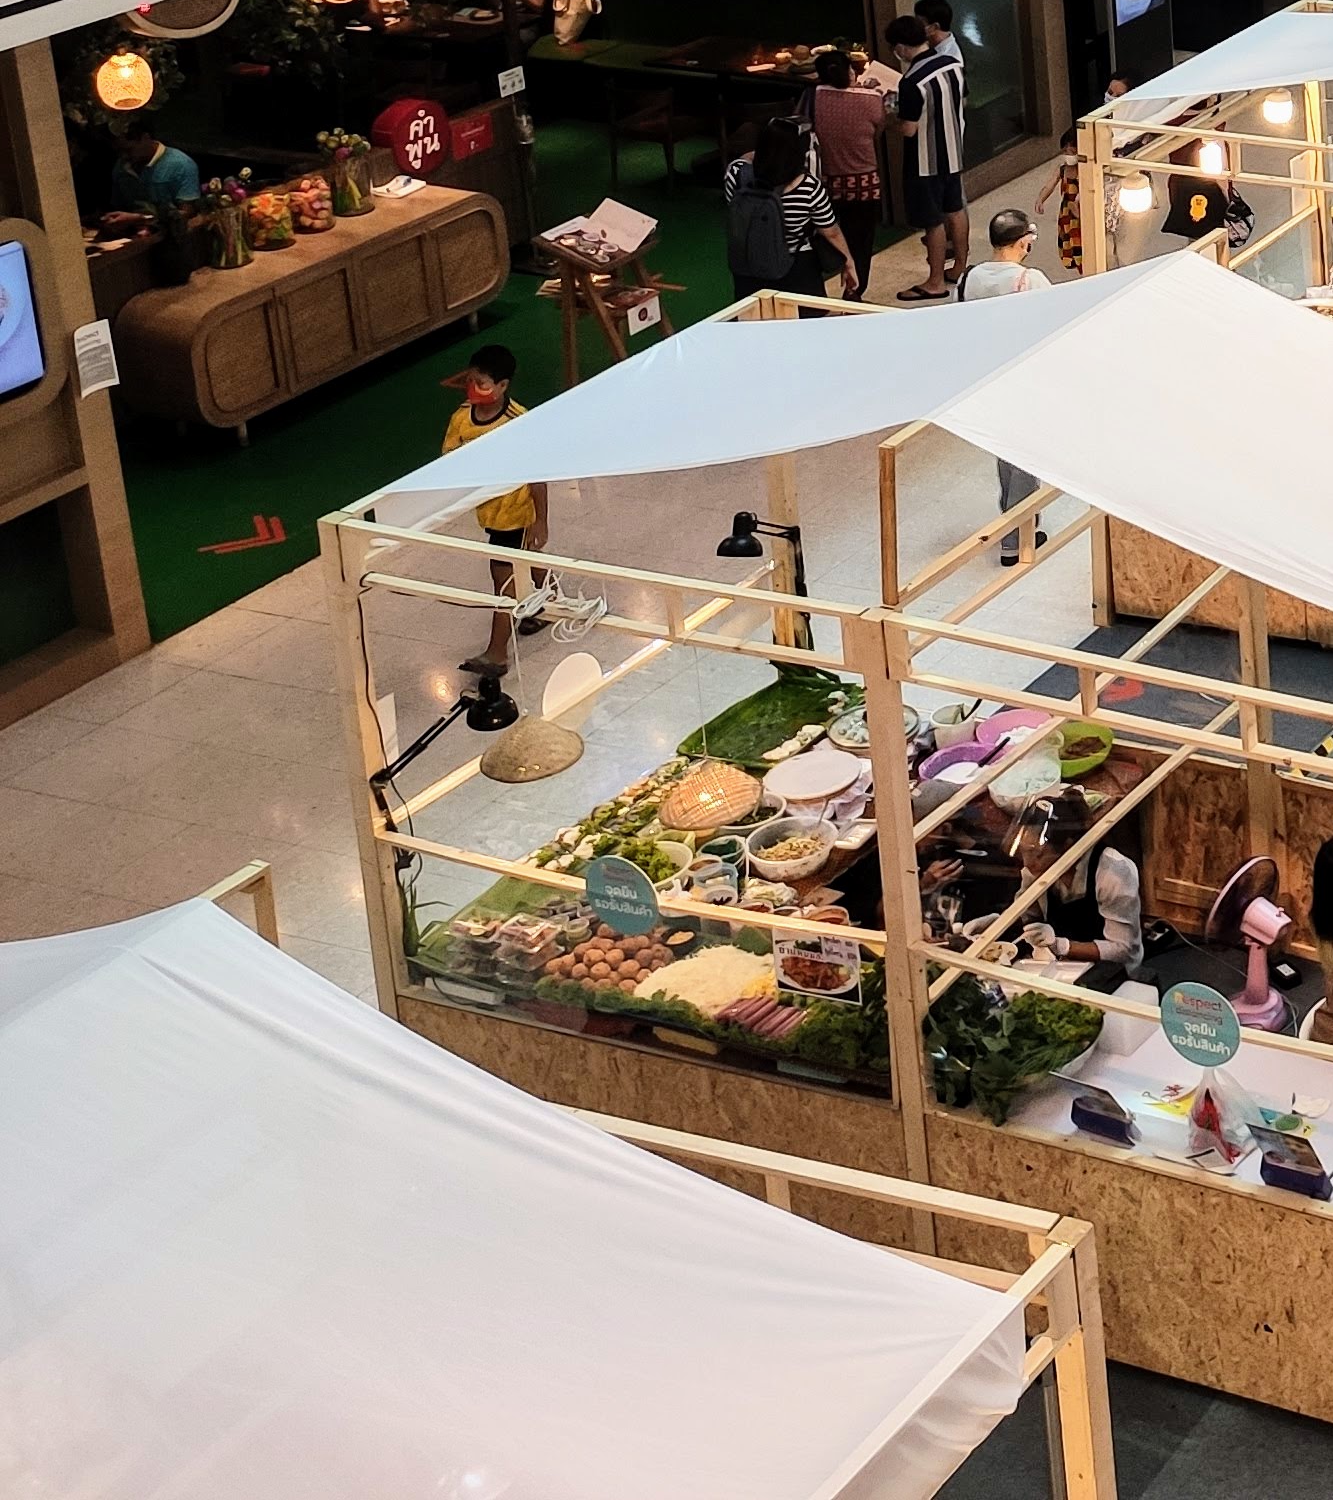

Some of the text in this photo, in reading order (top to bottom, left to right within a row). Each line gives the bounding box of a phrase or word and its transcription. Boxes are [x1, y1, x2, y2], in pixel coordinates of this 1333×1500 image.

[409, 109, 435, 141] คำ
[404, 133, 440, 170] พูน
[1184, 1022, 1216, 1037] จุดยืน
[1172, 1034, 1231, 1057] รอรับสินค้า
